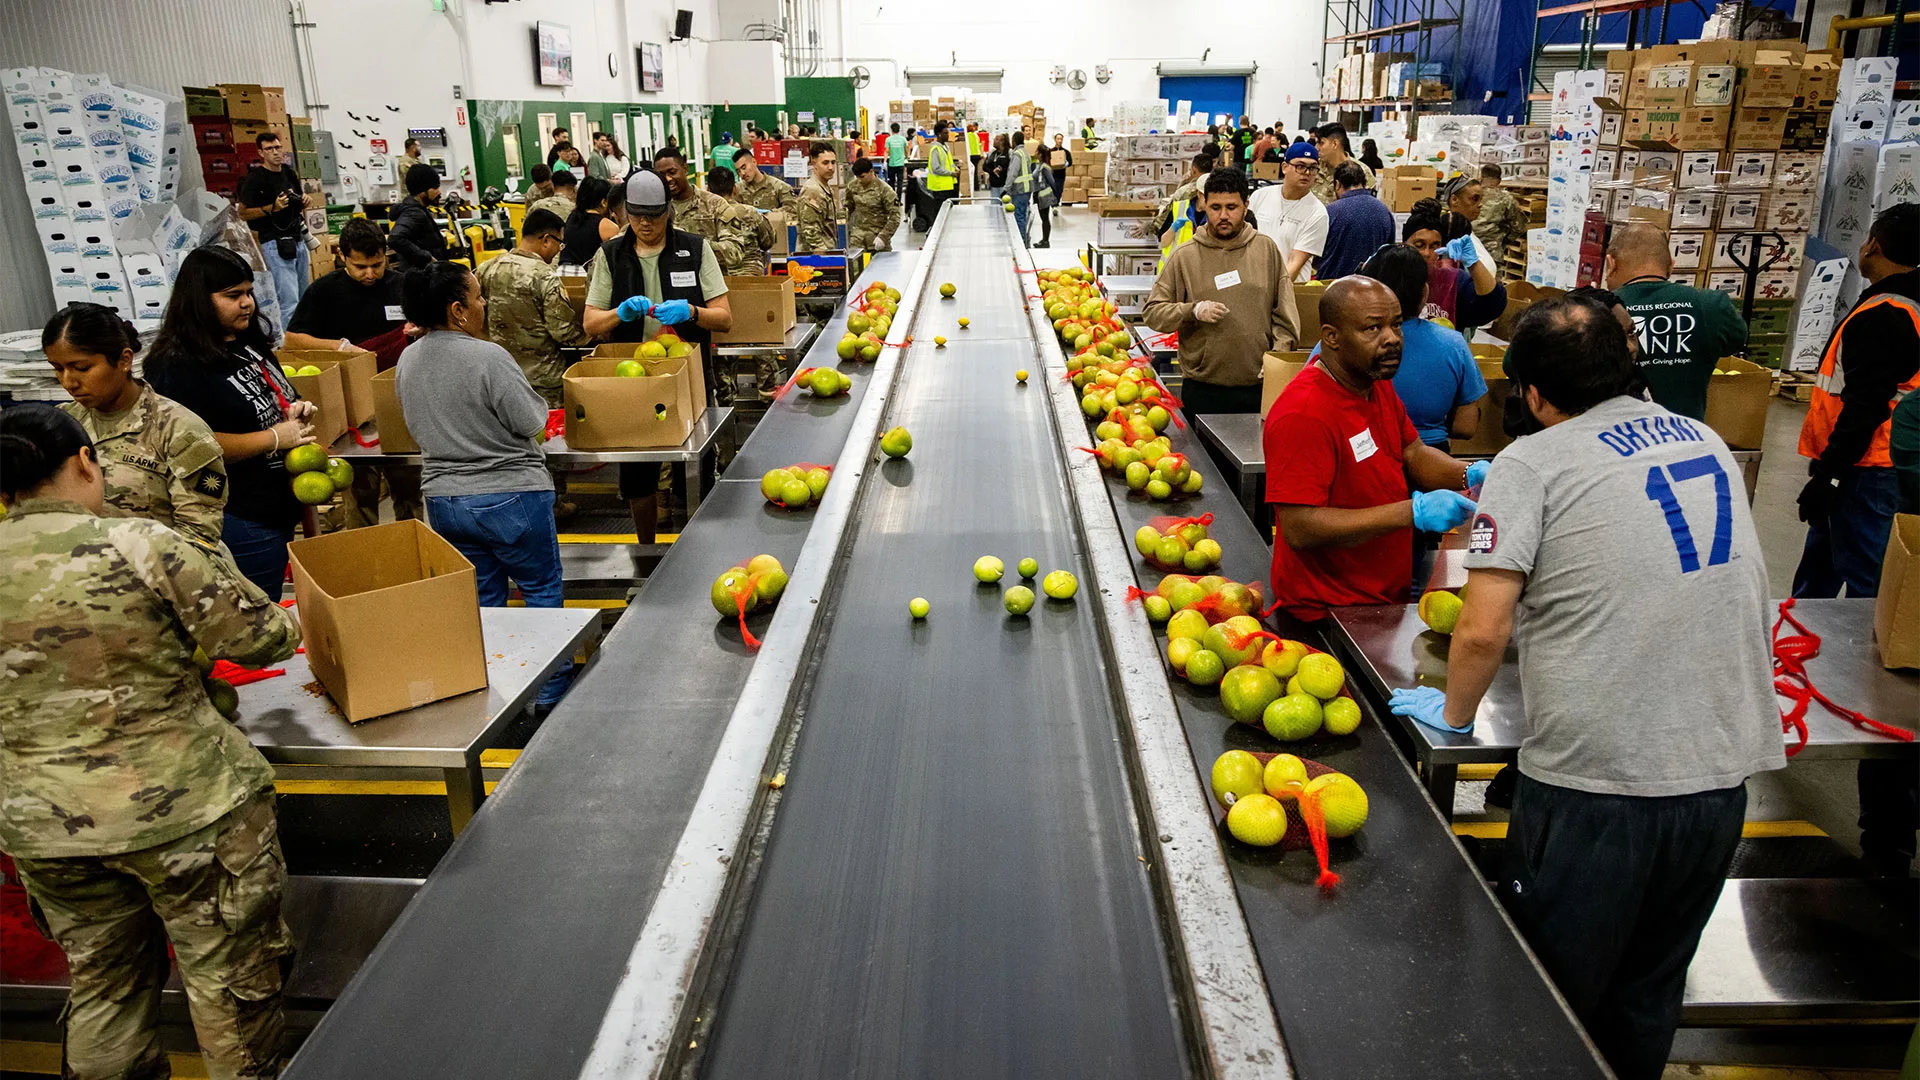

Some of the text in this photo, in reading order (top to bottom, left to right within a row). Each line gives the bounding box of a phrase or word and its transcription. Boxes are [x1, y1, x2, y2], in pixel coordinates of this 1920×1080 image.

[1655, 301, 1693, 310] REGIONAL
[1649, 313, 1696, 335] OD
[1652, 358, 1673, 366] Giving
[1674, 357, 1692, 365] Hope.
[1598, 415, 1704, 457] OHTANI
[1645, 454, 1732, 573] 17
